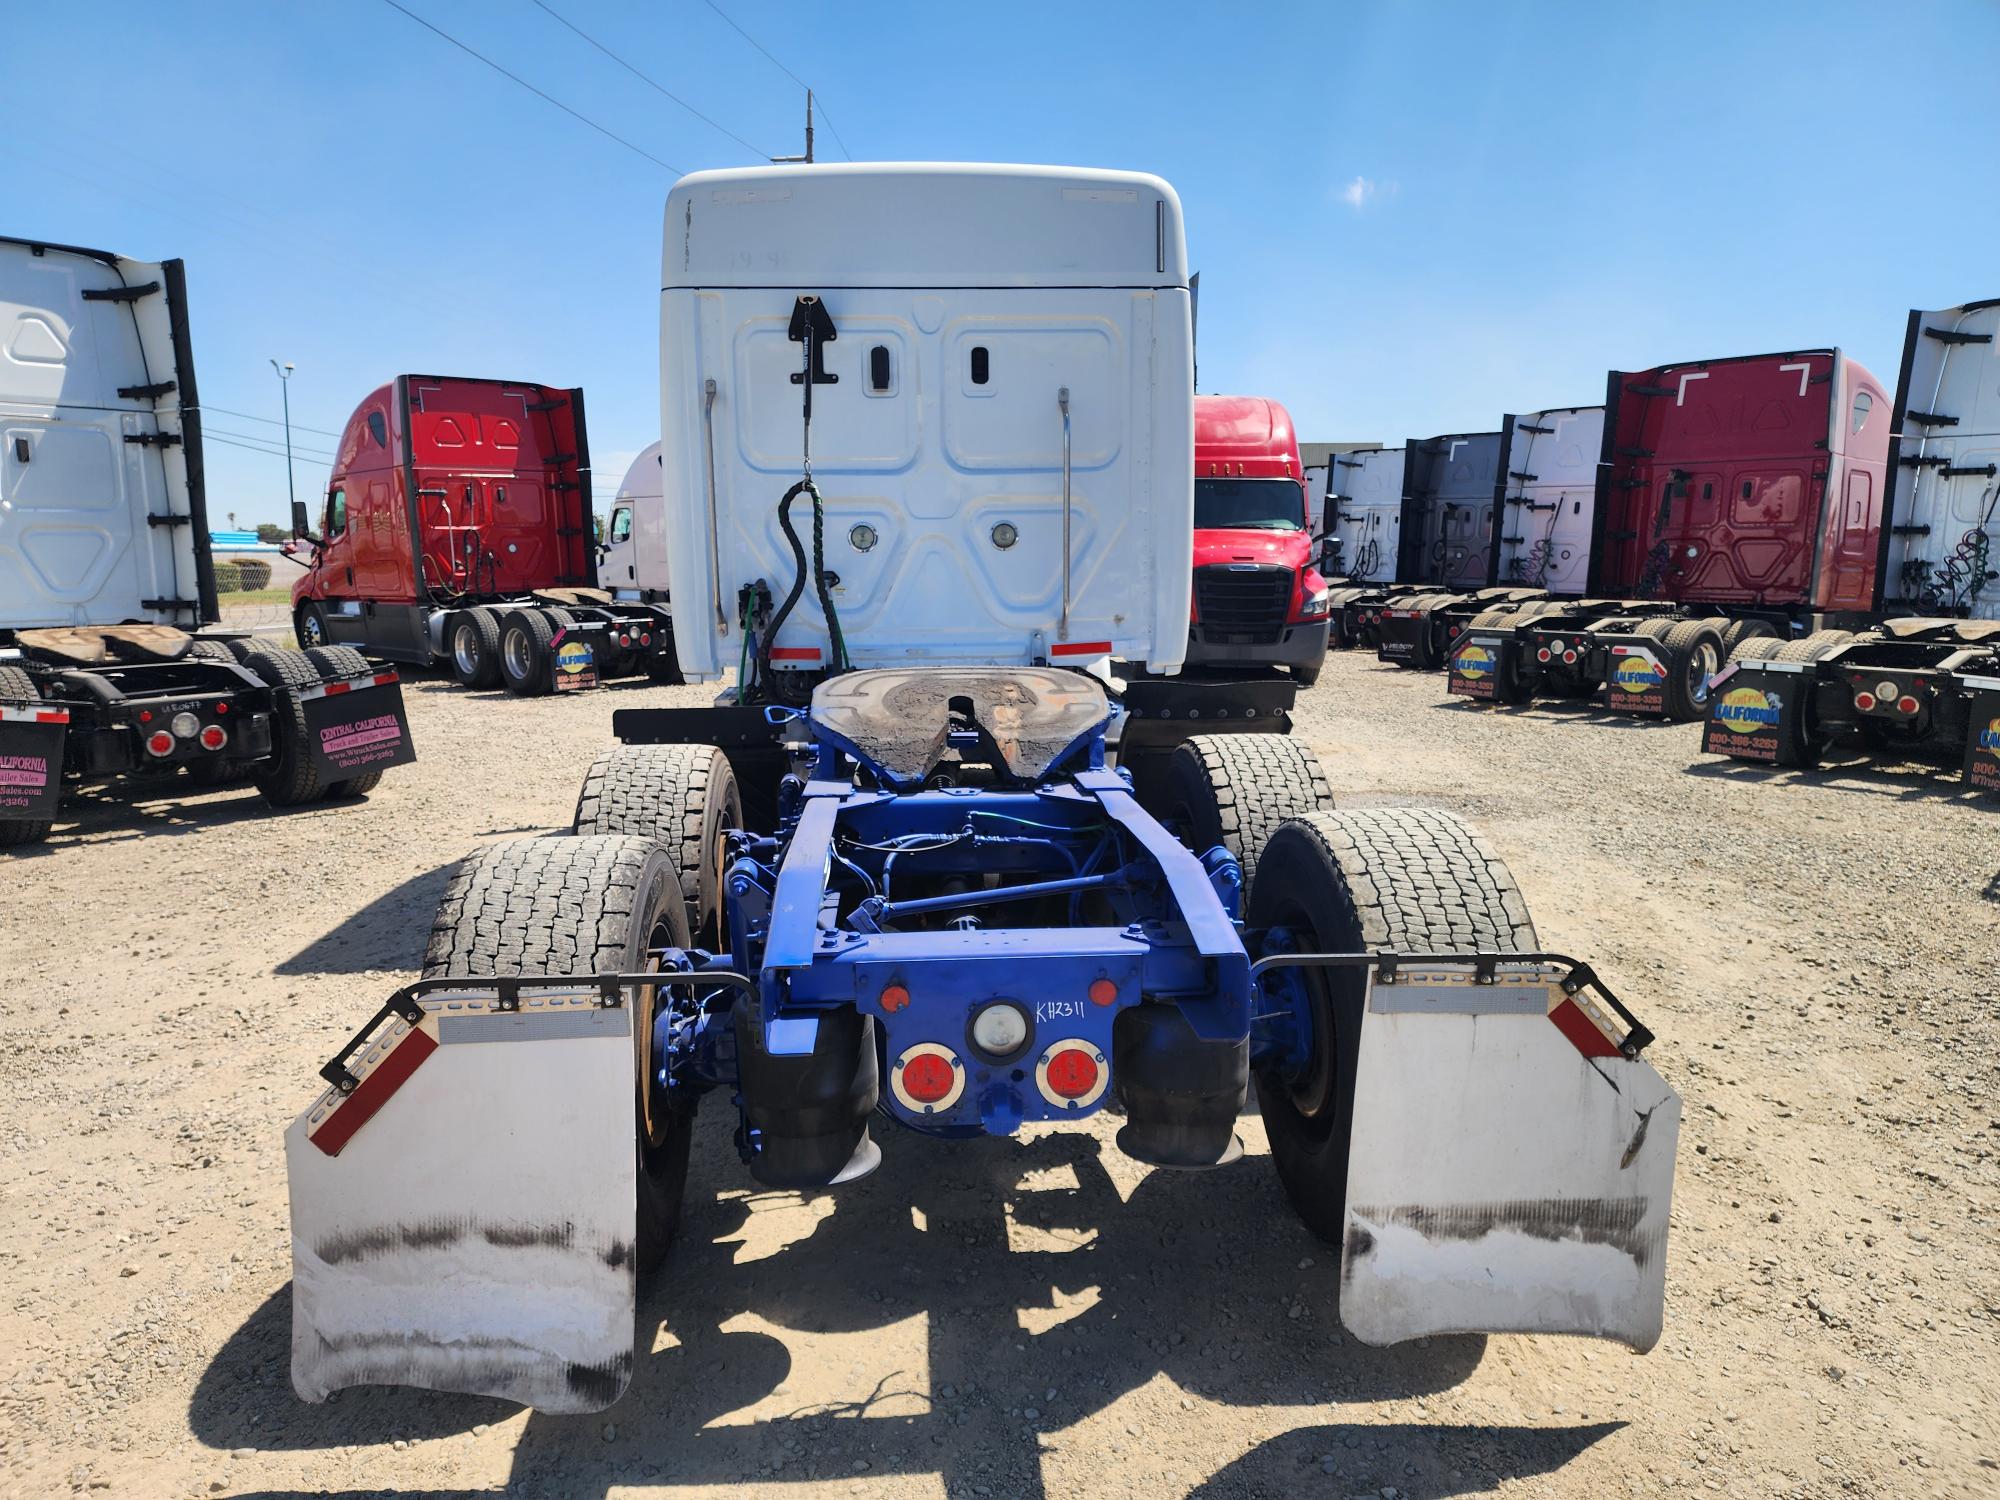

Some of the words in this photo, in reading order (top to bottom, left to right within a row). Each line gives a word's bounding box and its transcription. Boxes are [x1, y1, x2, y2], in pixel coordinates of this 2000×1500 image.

[1713, 703, 1780, 725] CALIFORNIA
[320, 723, 355, 741] CENTRAL
[355, 714, 398, 731] CALIFORNIA
[1036, 1000, 1085, 1024] KH2311
